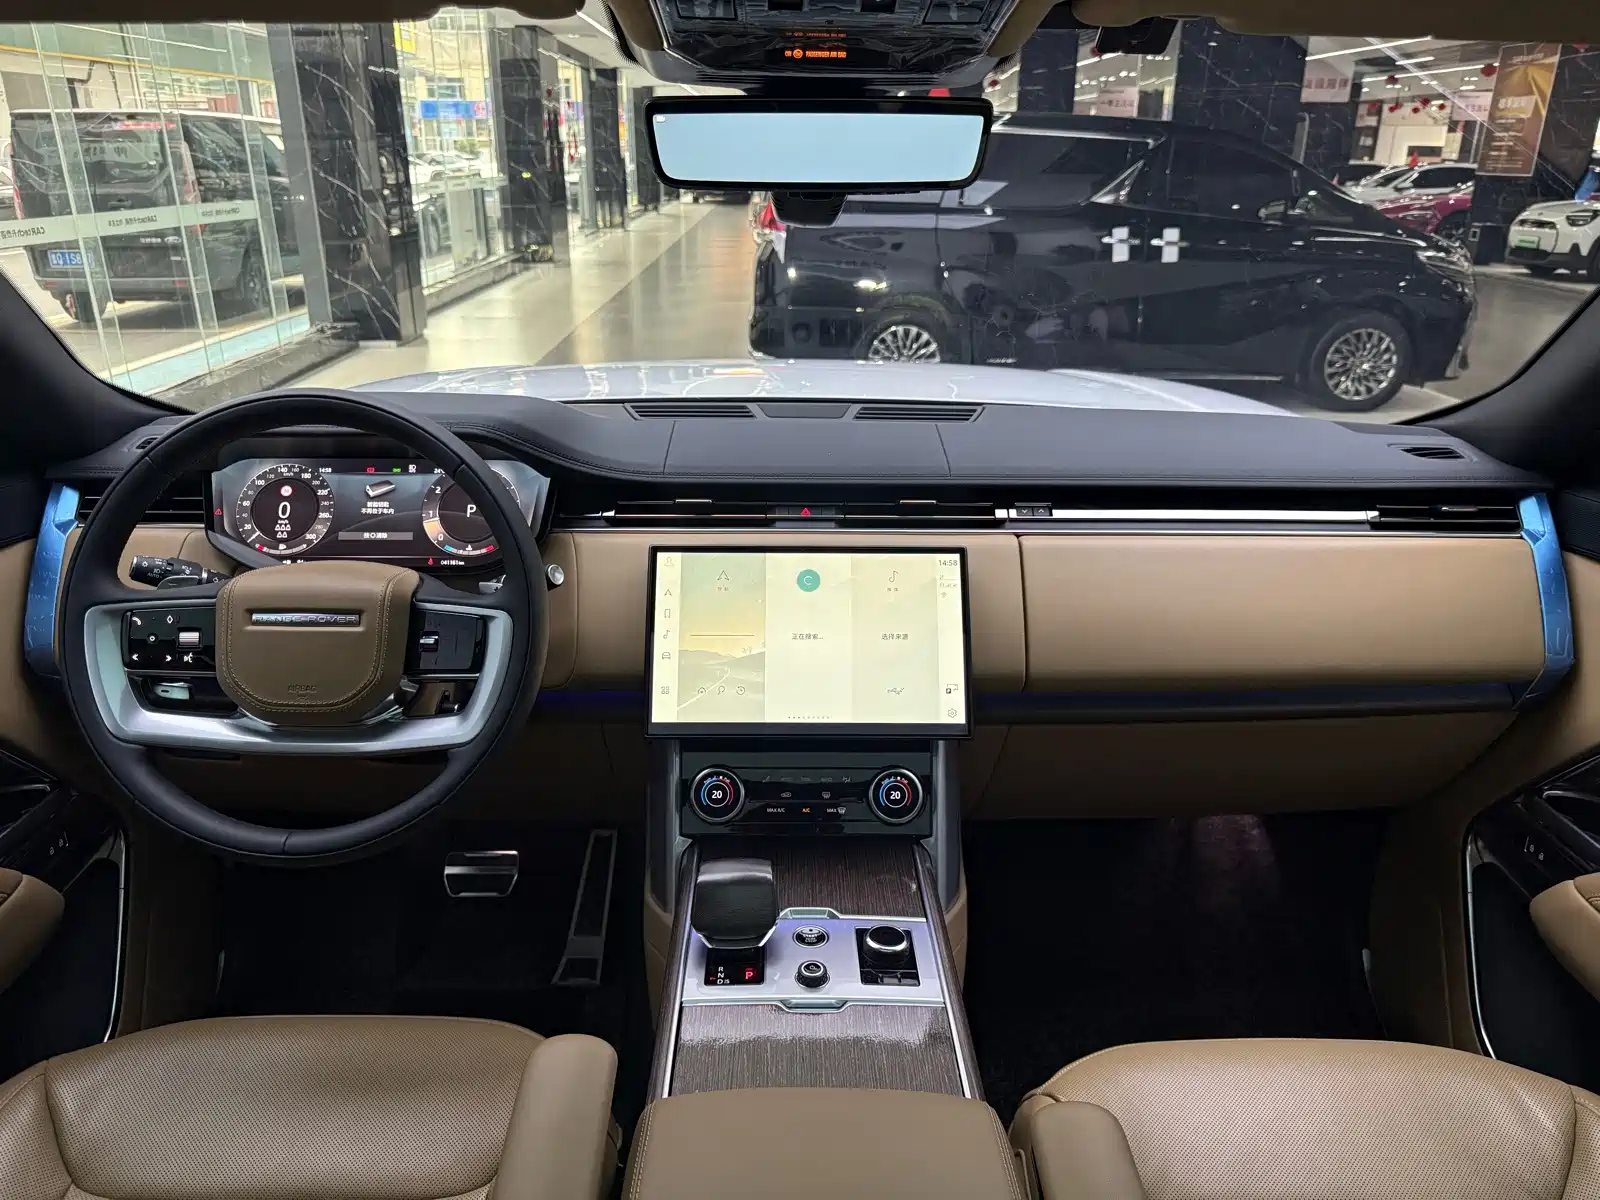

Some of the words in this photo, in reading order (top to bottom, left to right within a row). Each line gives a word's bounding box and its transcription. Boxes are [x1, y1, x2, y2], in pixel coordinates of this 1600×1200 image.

[278, 502, 291, 518] 0
[466, 504, 476, 518] P
[287, 684, 317, 693] AIRBAG
[712, 790, 722, 799] 20
[890, 791, 900, 799] 20
